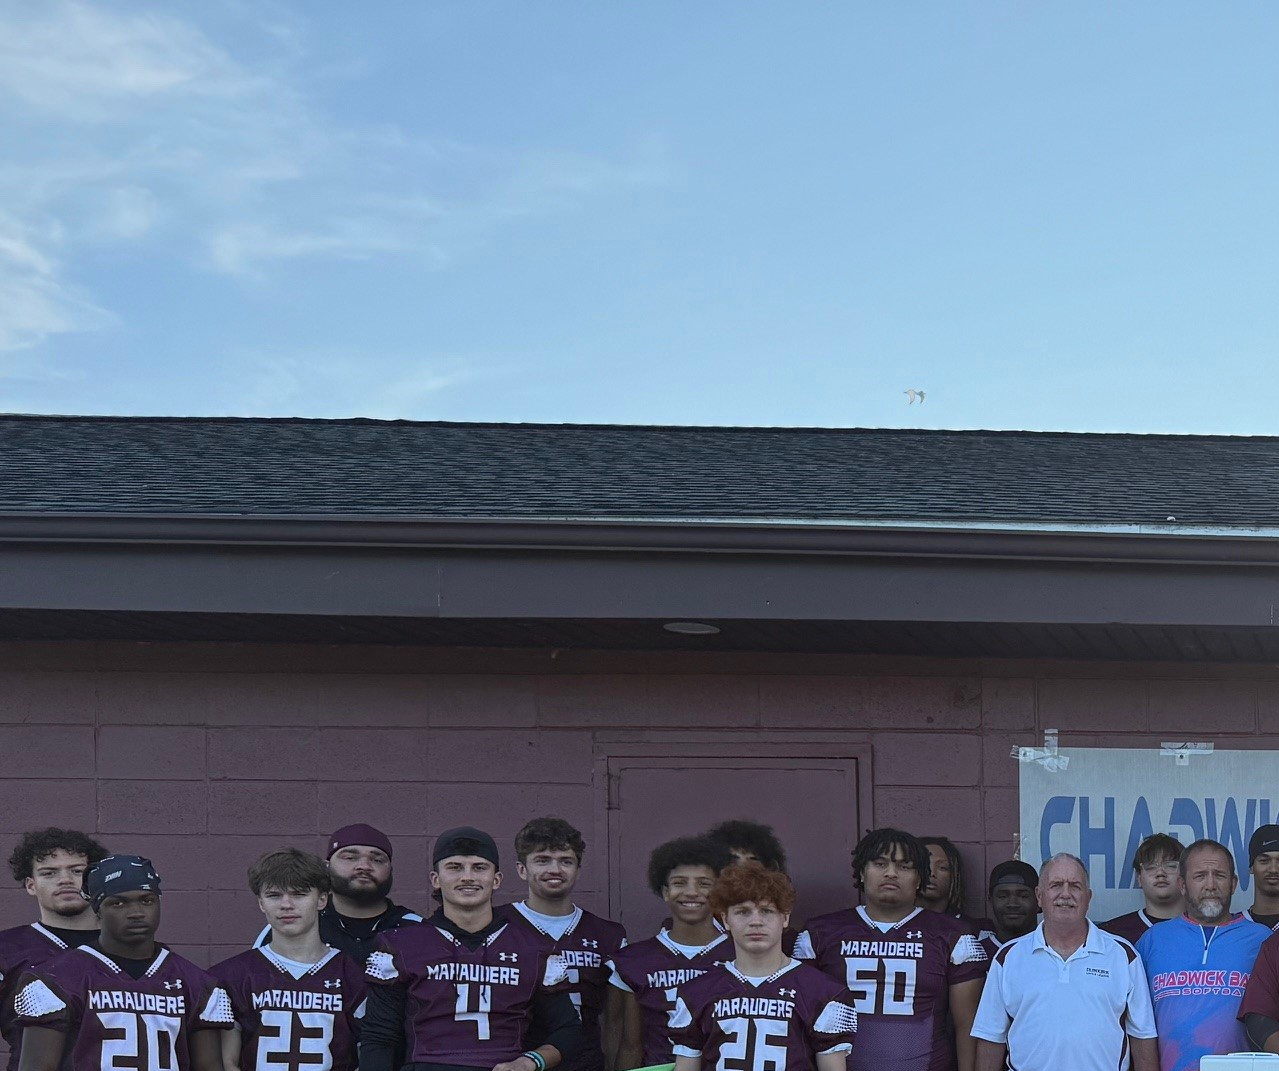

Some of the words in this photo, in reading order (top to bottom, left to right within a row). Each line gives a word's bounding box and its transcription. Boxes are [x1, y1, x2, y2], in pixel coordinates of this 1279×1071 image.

[841, 940, 923, 958] MARAUDERS
[426, 962, 520, 986] MARAUDERS
[1152, 970, 1226, 992] CHADWICK
[1228, 970, 1250, 989] BA
[845, 957, 917, 1016] 50
[1182, 987, 1245, 998] SOFTBA
[89, 990, 186, 1015] MARAUDERS
[252, 990, 343, 1012] MARAUDERS
[454, 983, 491, 1040] 4
[712, 997, 795, 1018] MARAUDERS
